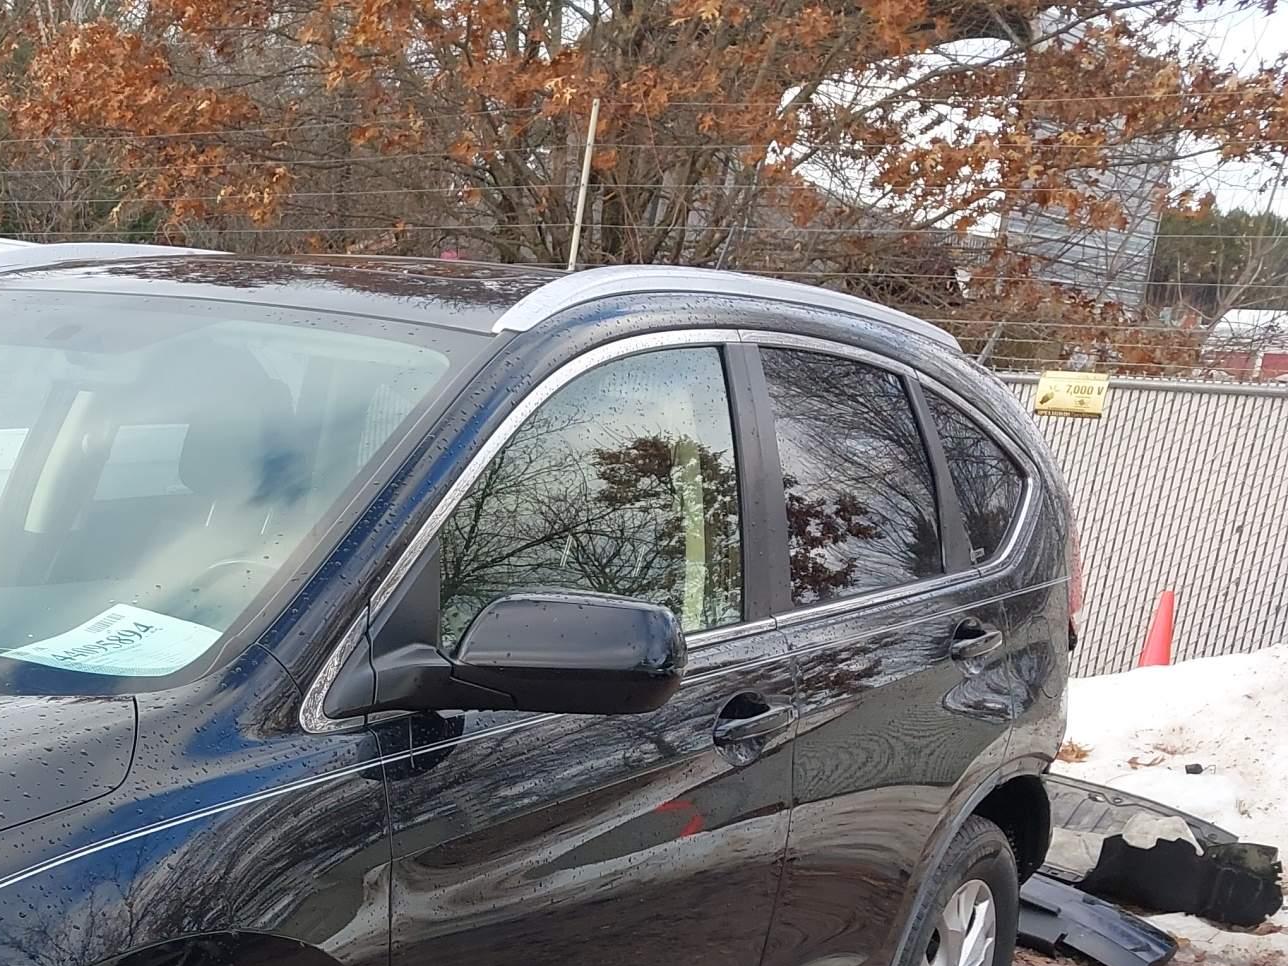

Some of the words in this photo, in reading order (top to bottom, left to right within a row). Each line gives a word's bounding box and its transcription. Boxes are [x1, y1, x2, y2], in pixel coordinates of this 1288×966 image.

[1066, 384, 1094, 396] 7,000
[1097, 385, 1104, 396] V
[51, 621, 154, 661] 44095894
